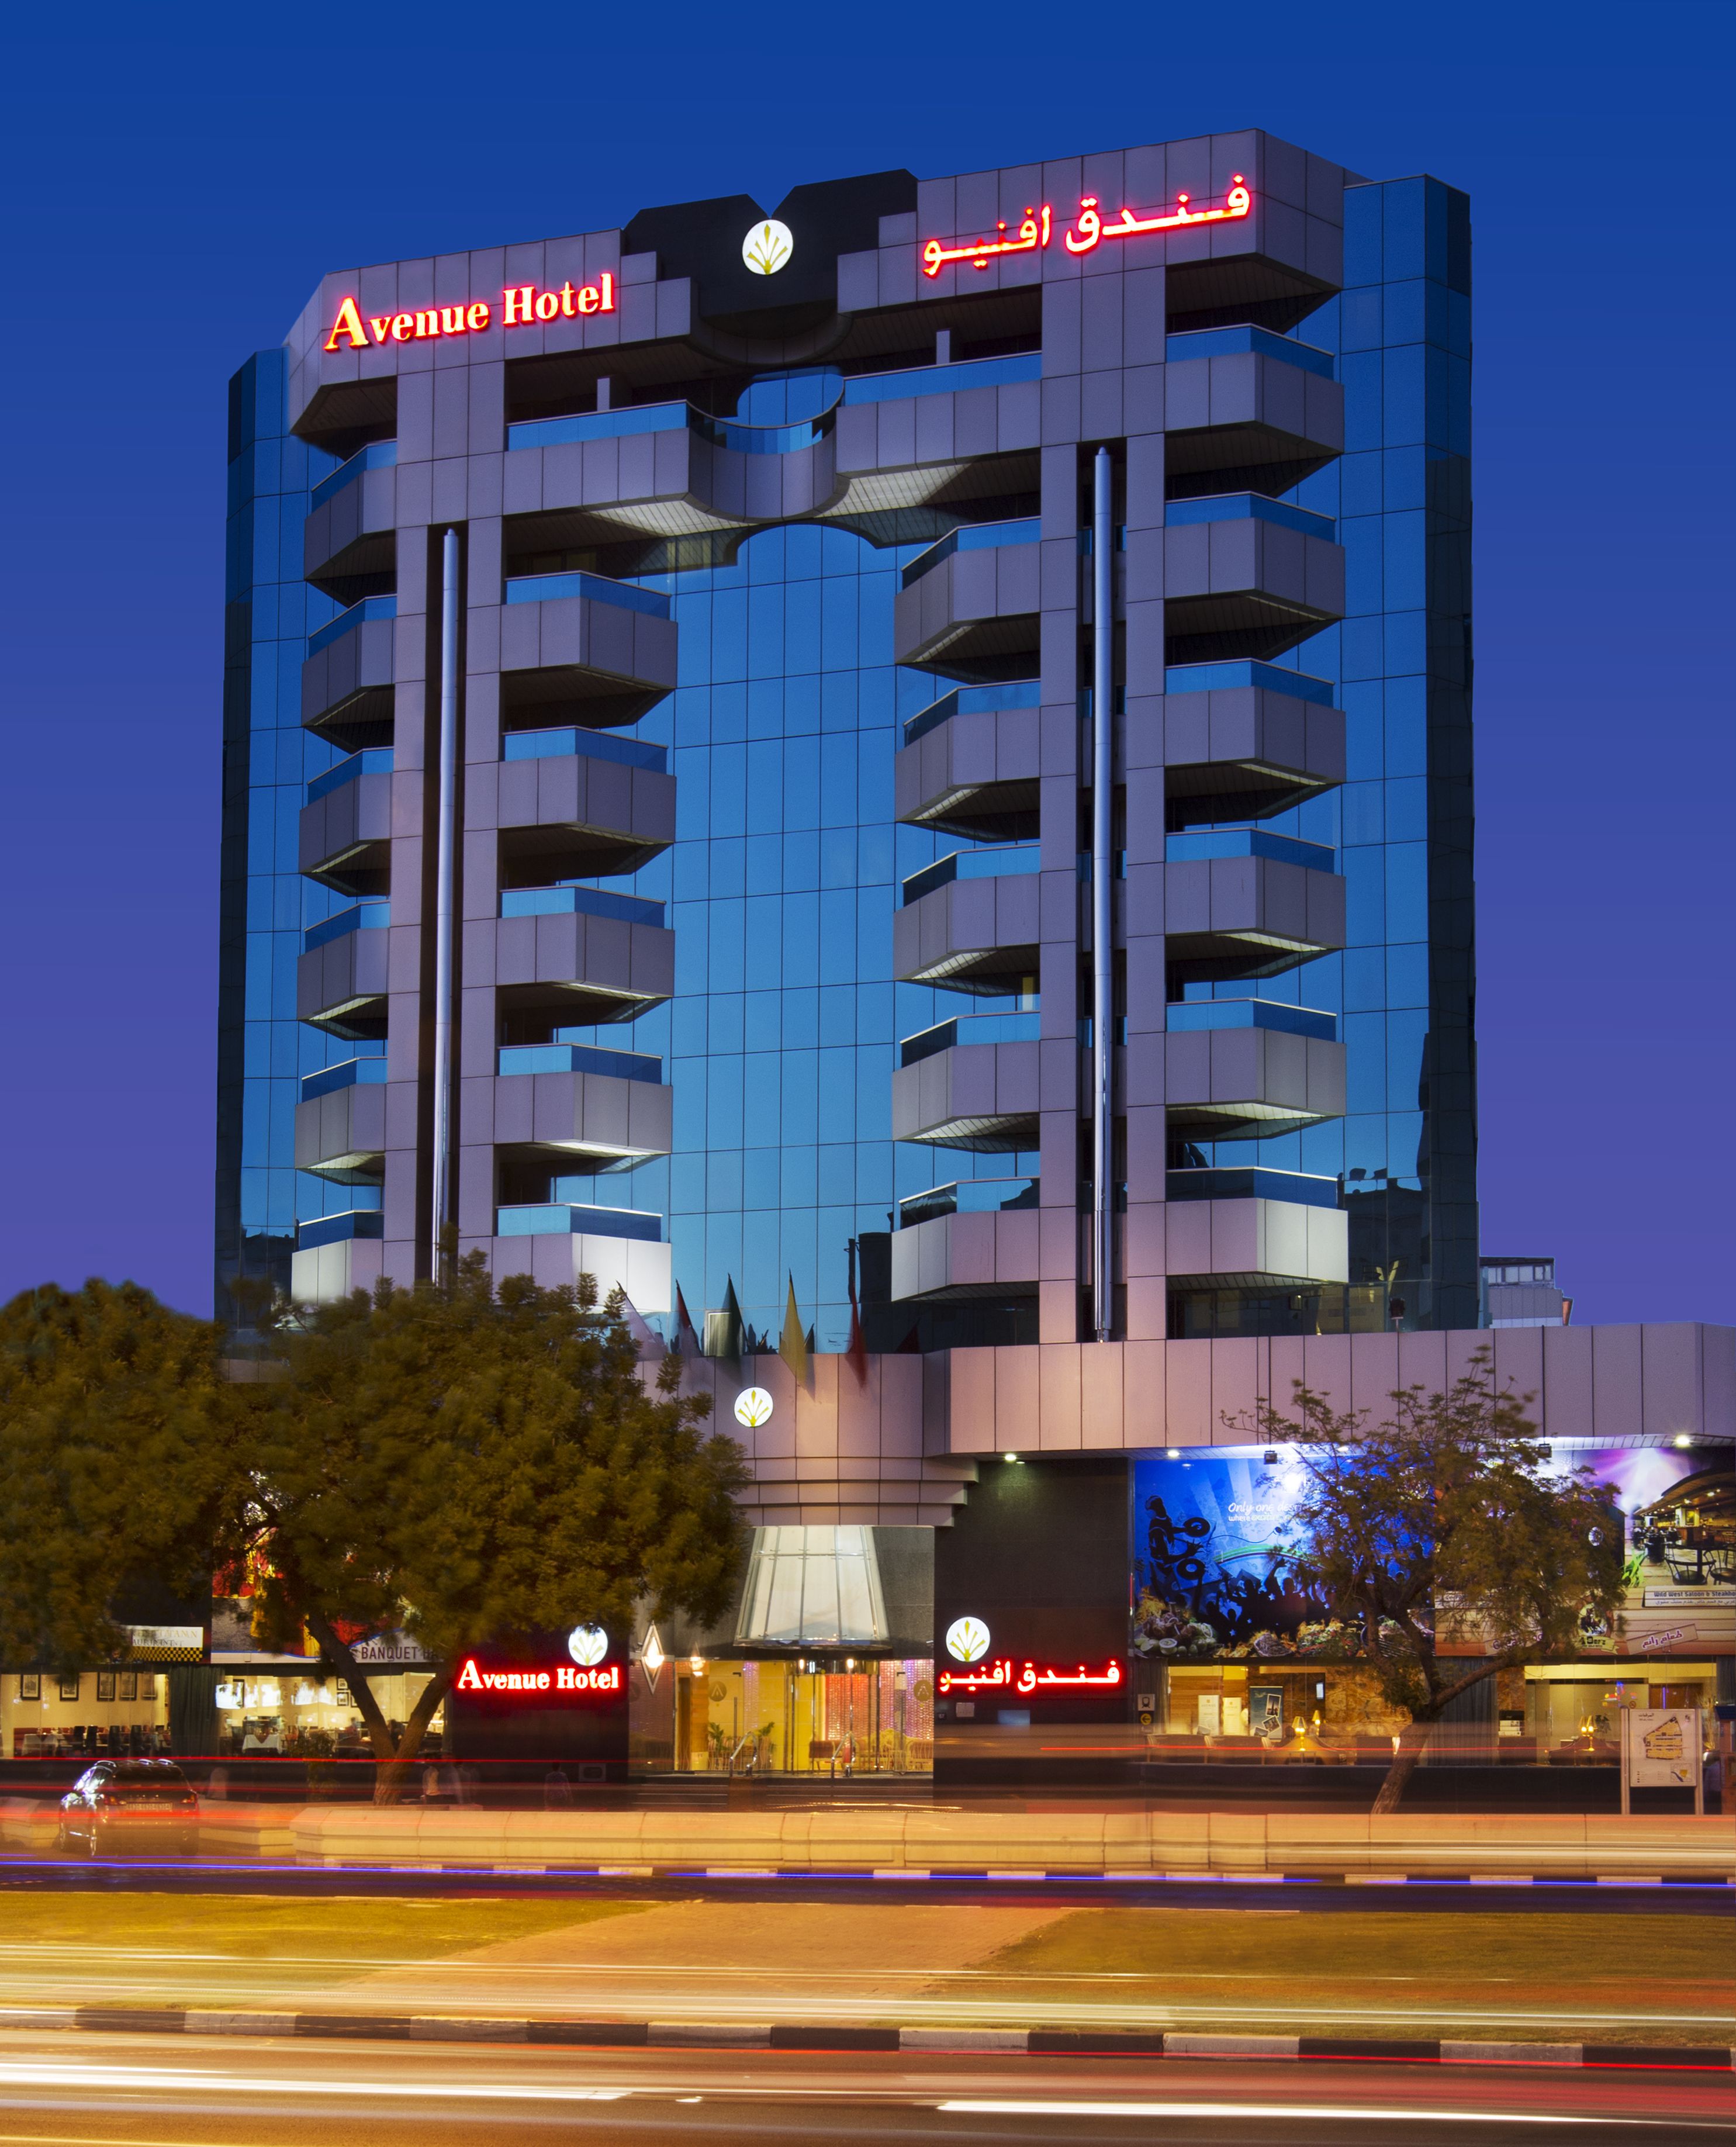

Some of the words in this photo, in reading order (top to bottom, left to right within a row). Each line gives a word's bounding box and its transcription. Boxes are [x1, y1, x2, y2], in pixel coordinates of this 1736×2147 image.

[1065, 174, 1251, 257] فندق
[323, 296, 491, 352] Avenue
[502, 272, 615, 327] Hotel
[1228, 1501, 1253, 1516] Only
[1255, 1503, 1274, 1512] one
[1661, 1629, 1683, 1644] طعام
[361, 1646, 419, 1662] BANQUET
[457, 1659, 551, 1689] Avenue
[556, 1667, 620, 1689] Hotel
[1017, 1660, 1120, 1692] فندق
